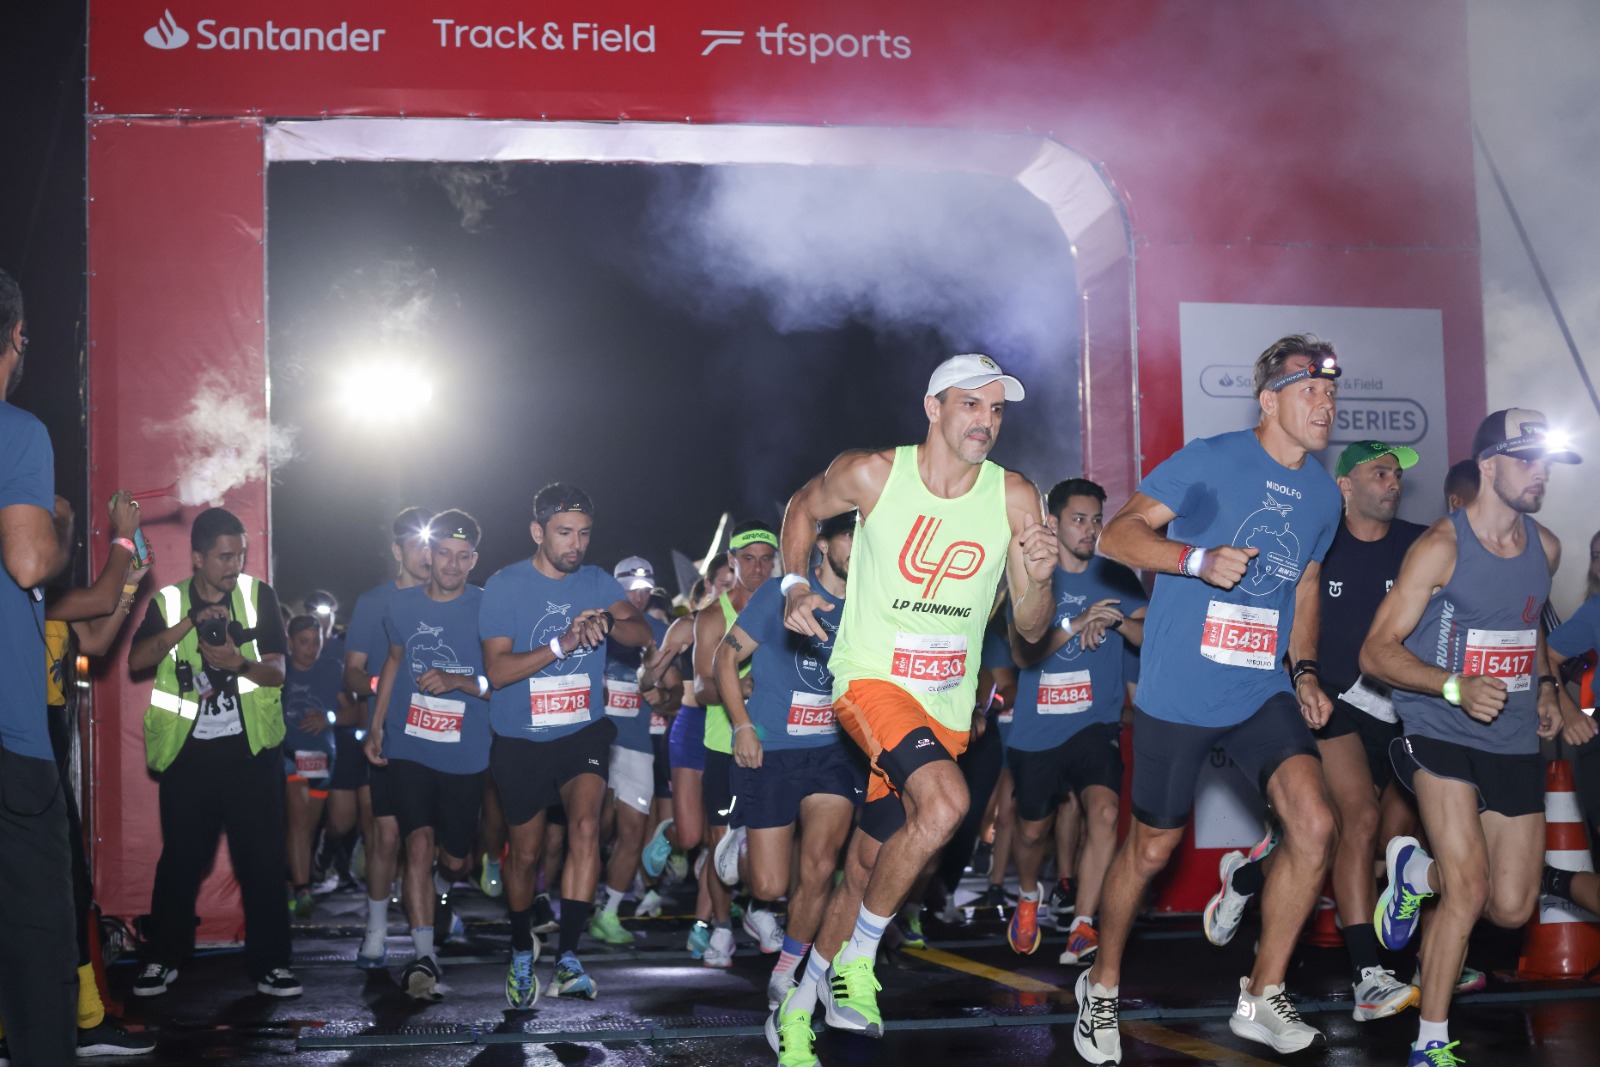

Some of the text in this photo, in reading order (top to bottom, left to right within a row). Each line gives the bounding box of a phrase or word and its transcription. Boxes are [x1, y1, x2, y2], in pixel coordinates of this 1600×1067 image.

[196, 19, 386, 51] Santander
[432, 18, 537, 49] Track
[572, 22, 656, 52] Field
[756, 22, 912, 64] tfsports
[1353, 378, 1384, 391] Field
[1266, 480, 1302, 500] NIDOLFO
[892, 599, 972, 618] LP RUNNING
[1209, 626, 1218, 644] 4KM
[1226, 629, 1270, 651] 5431
[1436, 600, 1455, 669] RUNNING
[899, 657, 907, 674] 4KM
[913, 658, 961, 677] 5430
[1471, 655, 1479, 673] 4KM
[1488, 655, 1529, 673] 5417
[551, 694, 585, 711] 5718
[612, 695, 638, 708] 5731
[1050, 687, 1089, 703] 5484
[422, 713, 458, 730] 5722
[804, 710, 837, 724] 542
